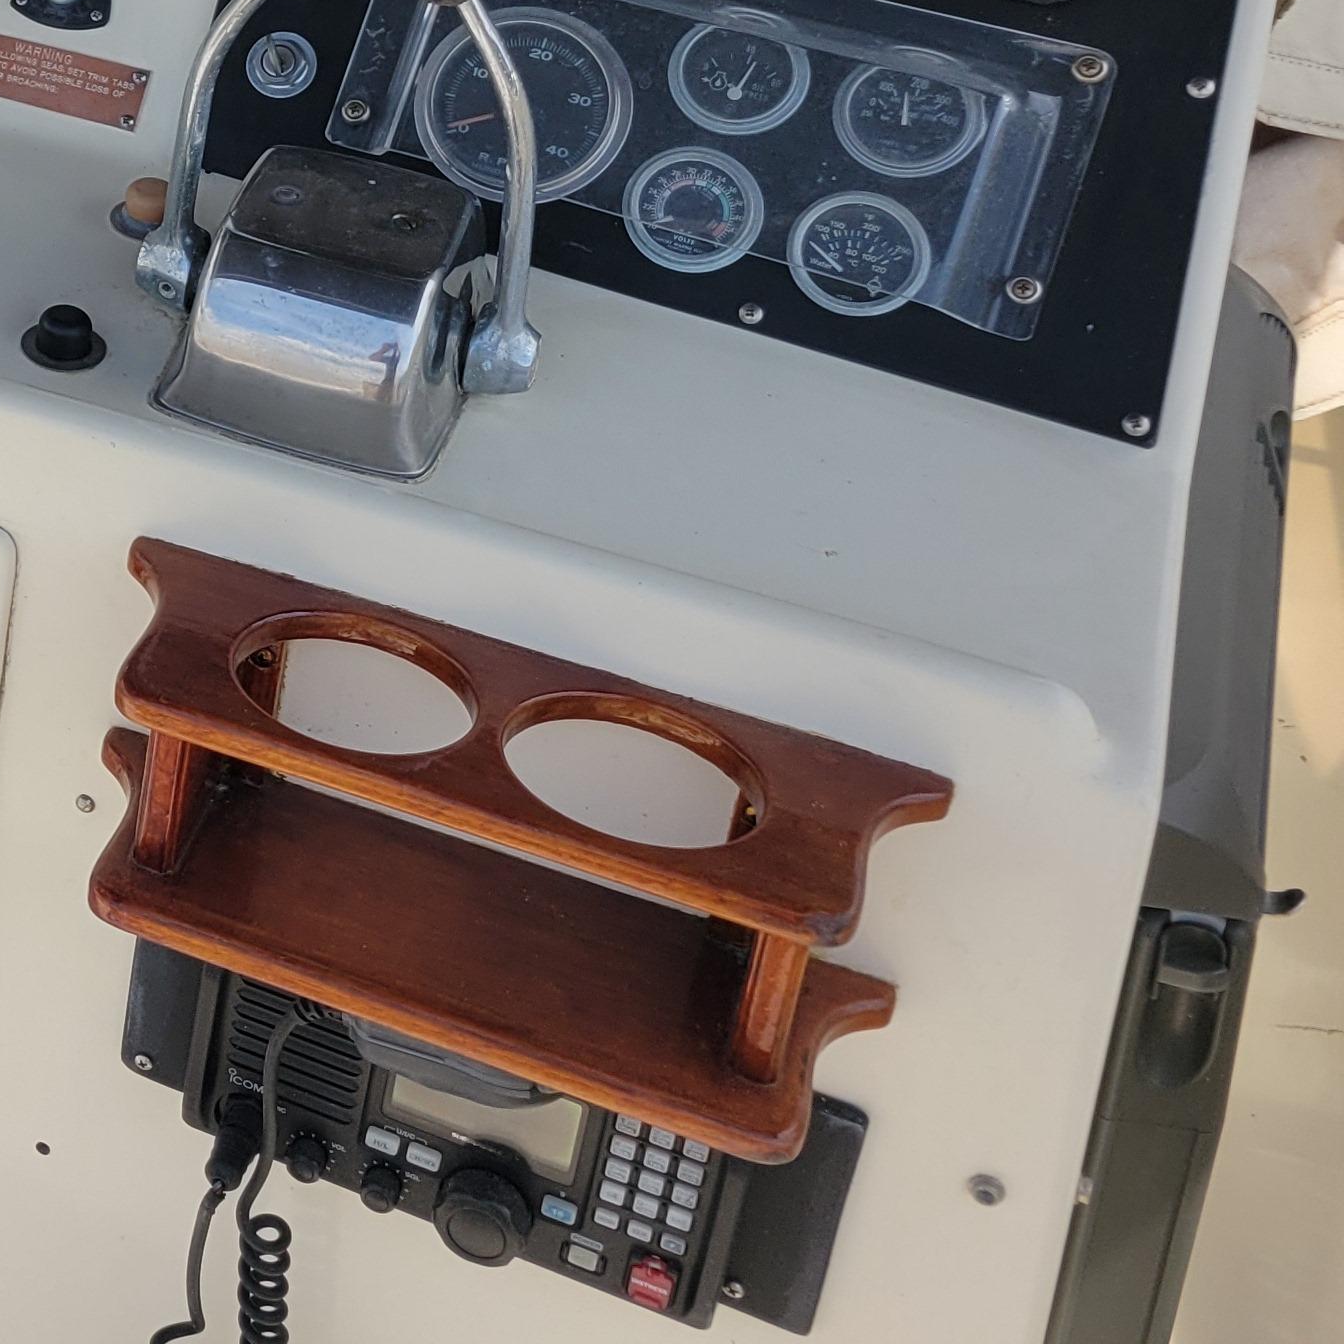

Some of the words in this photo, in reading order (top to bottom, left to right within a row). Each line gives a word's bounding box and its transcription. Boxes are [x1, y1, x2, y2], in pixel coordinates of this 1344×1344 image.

[15, 42, 73, 65] WARNING
[529, 48, 553, 61] 20
[67, 67, 85, 78] SET
[87, 71, 109, 84] TRIM
[112, 78, 135, 91] TABS
[473, 67, 488, 78] 10
[10, 63, 37, 77] AVOID
[39, 71, 82, 89] POSSIBLE
[85, 83, 110, 95] LOSS
[112, 89, 125, 98] OF
[568, 93, 592, 106] 30
[546, 145, 569, 158] 40
